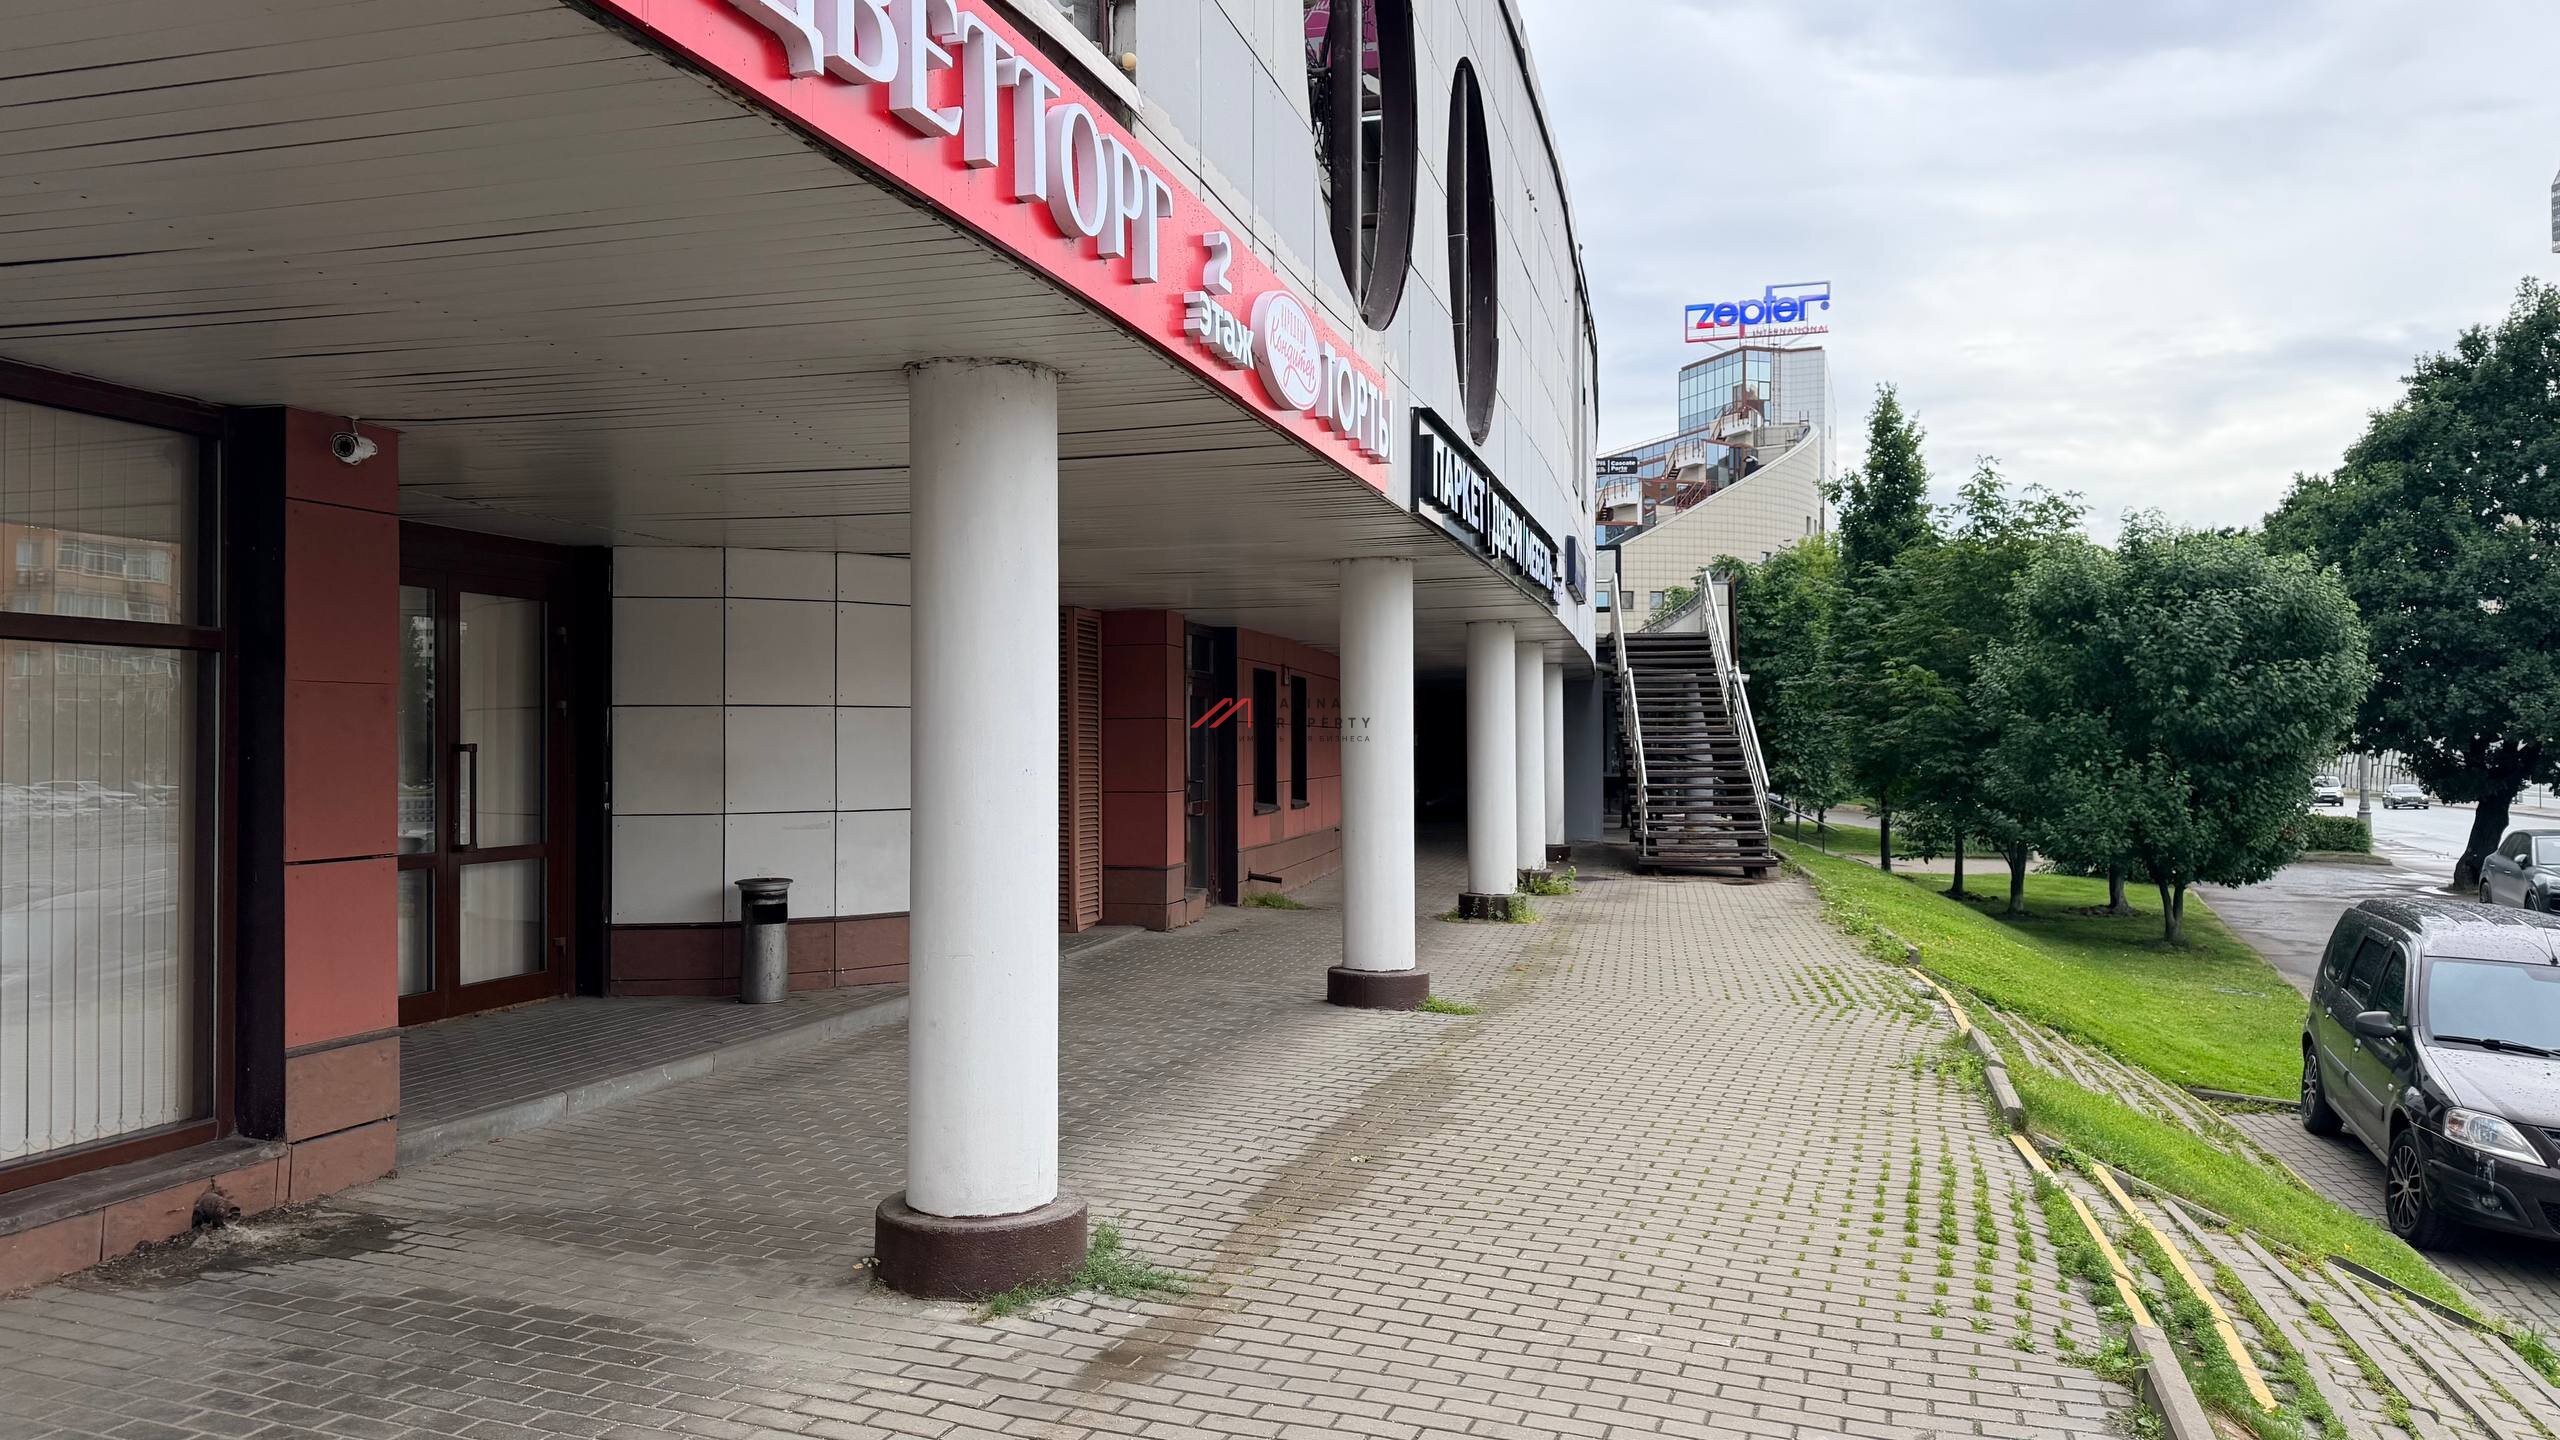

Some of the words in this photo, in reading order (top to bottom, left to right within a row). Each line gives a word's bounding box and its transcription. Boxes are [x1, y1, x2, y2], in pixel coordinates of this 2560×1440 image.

[1203, 231, 1232, 295] 2
[1752, 325, 1829, 337] INTERNATIONAL
[1315, 341, 1392, 464] ТОРТЫ
[1433, 434, 1486, 534] ПАРКЕТ
[1491, 491, 1523, 567] ДВЕРИ
